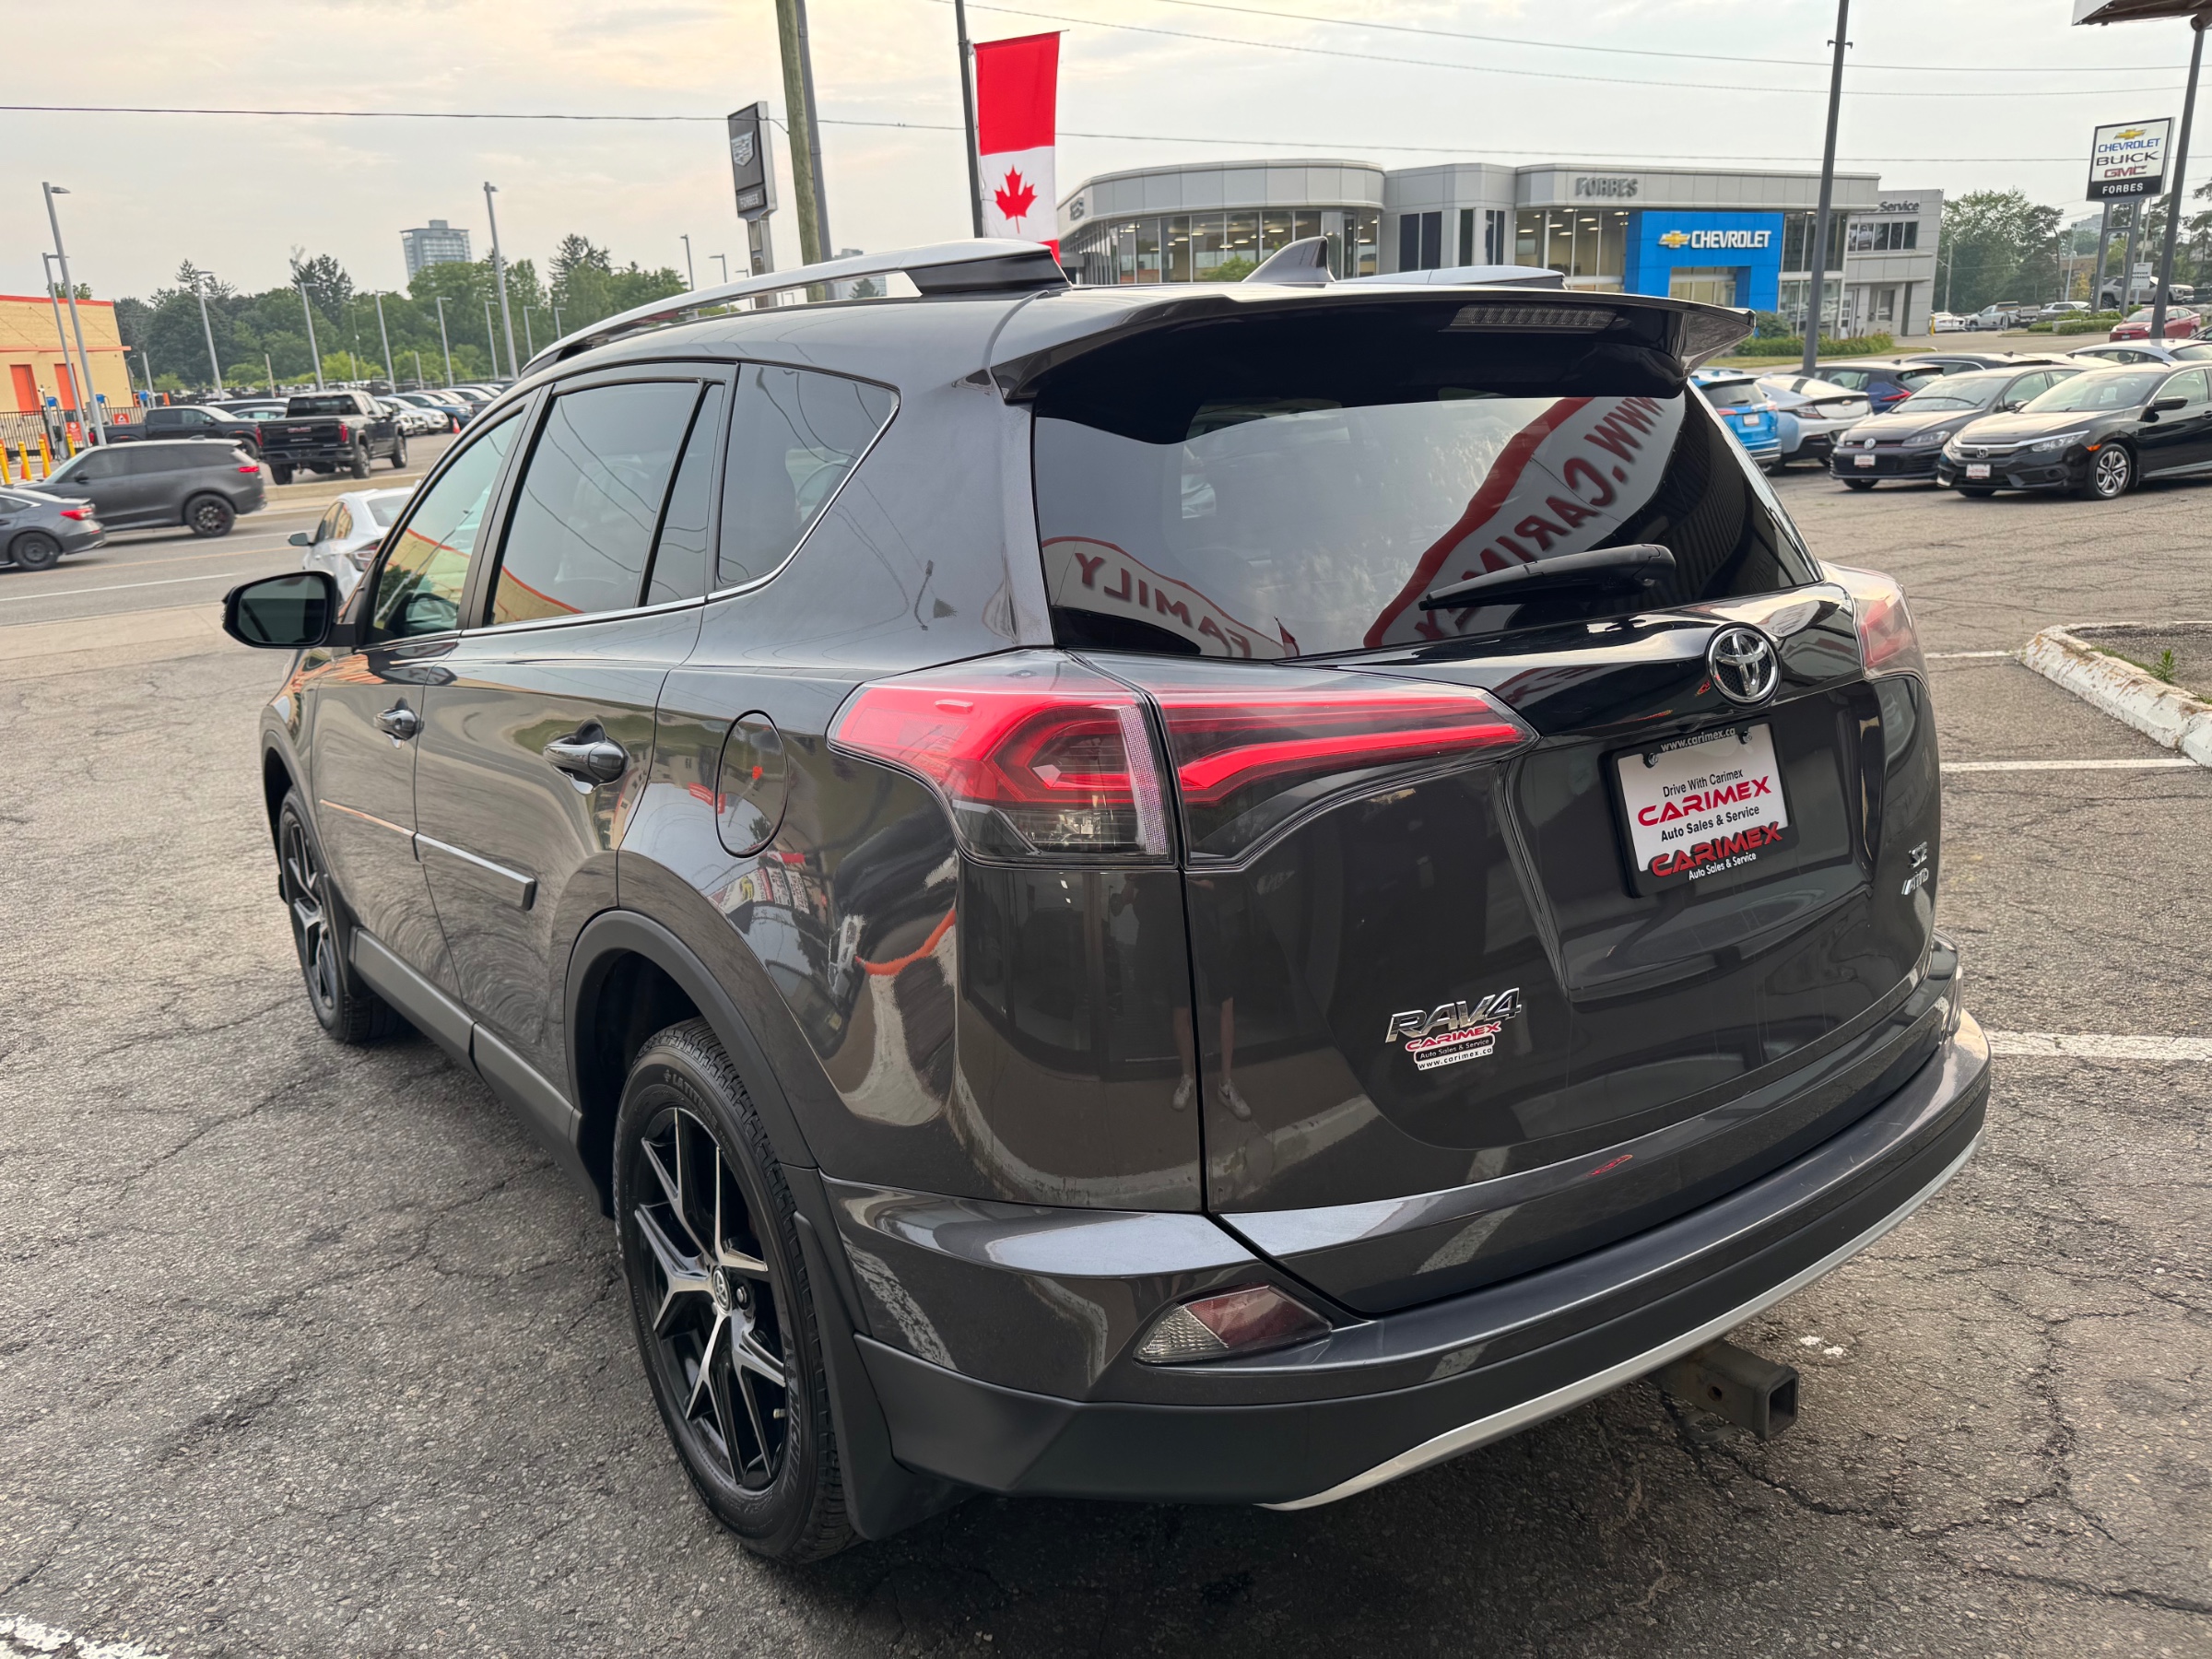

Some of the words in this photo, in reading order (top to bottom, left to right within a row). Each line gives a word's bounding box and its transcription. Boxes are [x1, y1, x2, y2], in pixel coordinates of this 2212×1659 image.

[2098, 138, 2160, 153] CHEVROLET
[2096, 151, 2159, 166] BUICK
[2104, 165, 2147, 178] GMC
[1575, 177, 1638, 197] FORBES
[2102, 182, 2144, 194] FORBES
[1880, 200, 1920, 211] Service
[1691, 230, 1771, 249] CHEVROLET
[1660, 727, 1735, 752] www.carimex.ca
[1663, 784, 1686, 797] Drive
[1688, 777, 1708, 791] With
[1709, 769, 1744, 785] Carimex
[1638, 776, 1771, 827] CARIMEX
[1661, 826, 1684, 841] Auto
[1687, 819, 1714, 834] Sales
[1716, 816, 1724, 826] &
[1725, 806, 1759, 822] Service
[1651, 822, 1783, 877] CARIMEX
[1688, 867, 1704, 880] Auto
[1706, 862, 1724, 875] Sales
[1725, 858, 1732, 868] &
[1733, 852, 1757, 866] Service
[1385, 987, 1522, 1043] RAV4
[1406, 1022, 1500, 1050] CARIMEX
[1418, 1047, 1493, 1070] www.carimex.ca
[1419, 1051, 1437, 1060] Auto
[1438, 1047, 1457, 1056] Sales
[1465, 1039, 1490, 1049] Service
[672, 1073, 718, 1130] LATITUDE
